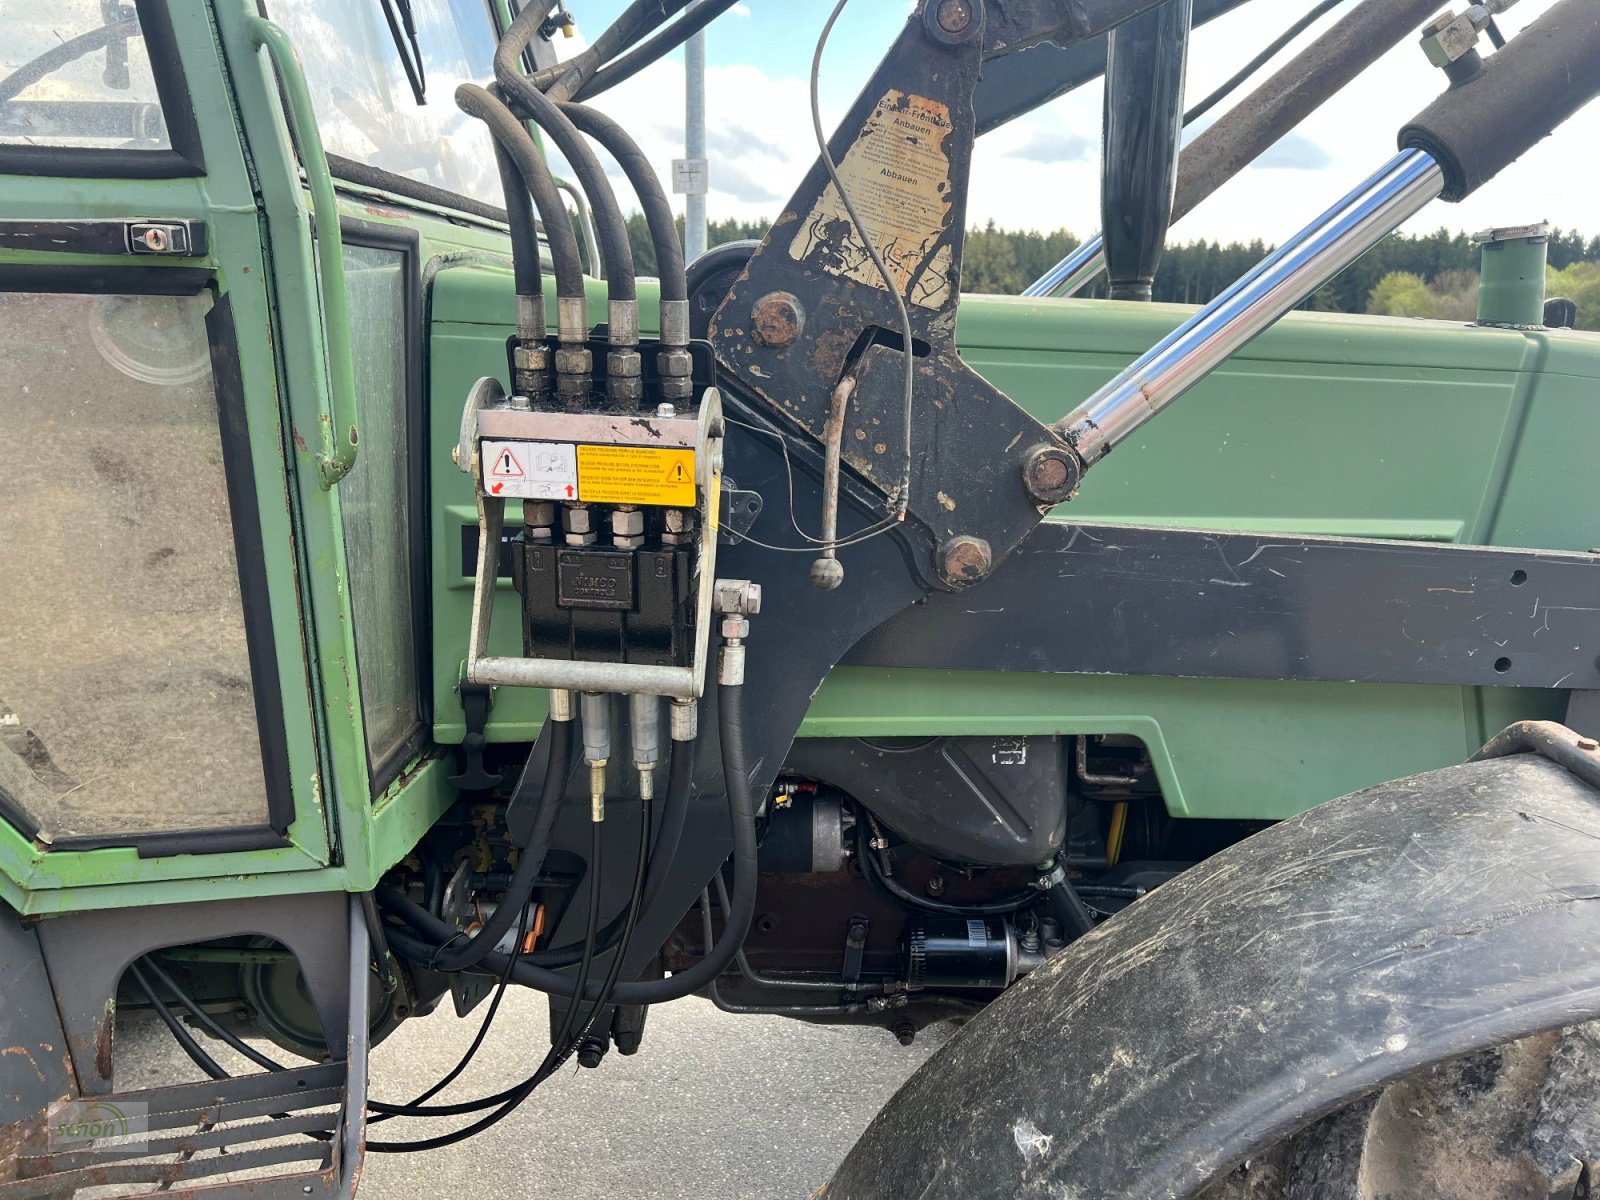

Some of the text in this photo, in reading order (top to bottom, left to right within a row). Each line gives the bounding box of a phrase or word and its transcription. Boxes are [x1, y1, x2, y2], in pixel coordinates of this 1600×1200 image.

[893, 117, 931, 136] Anbauen
[880, 167, 918, 186] Abbauen
[575, 576, 616, 588] NIMCO
